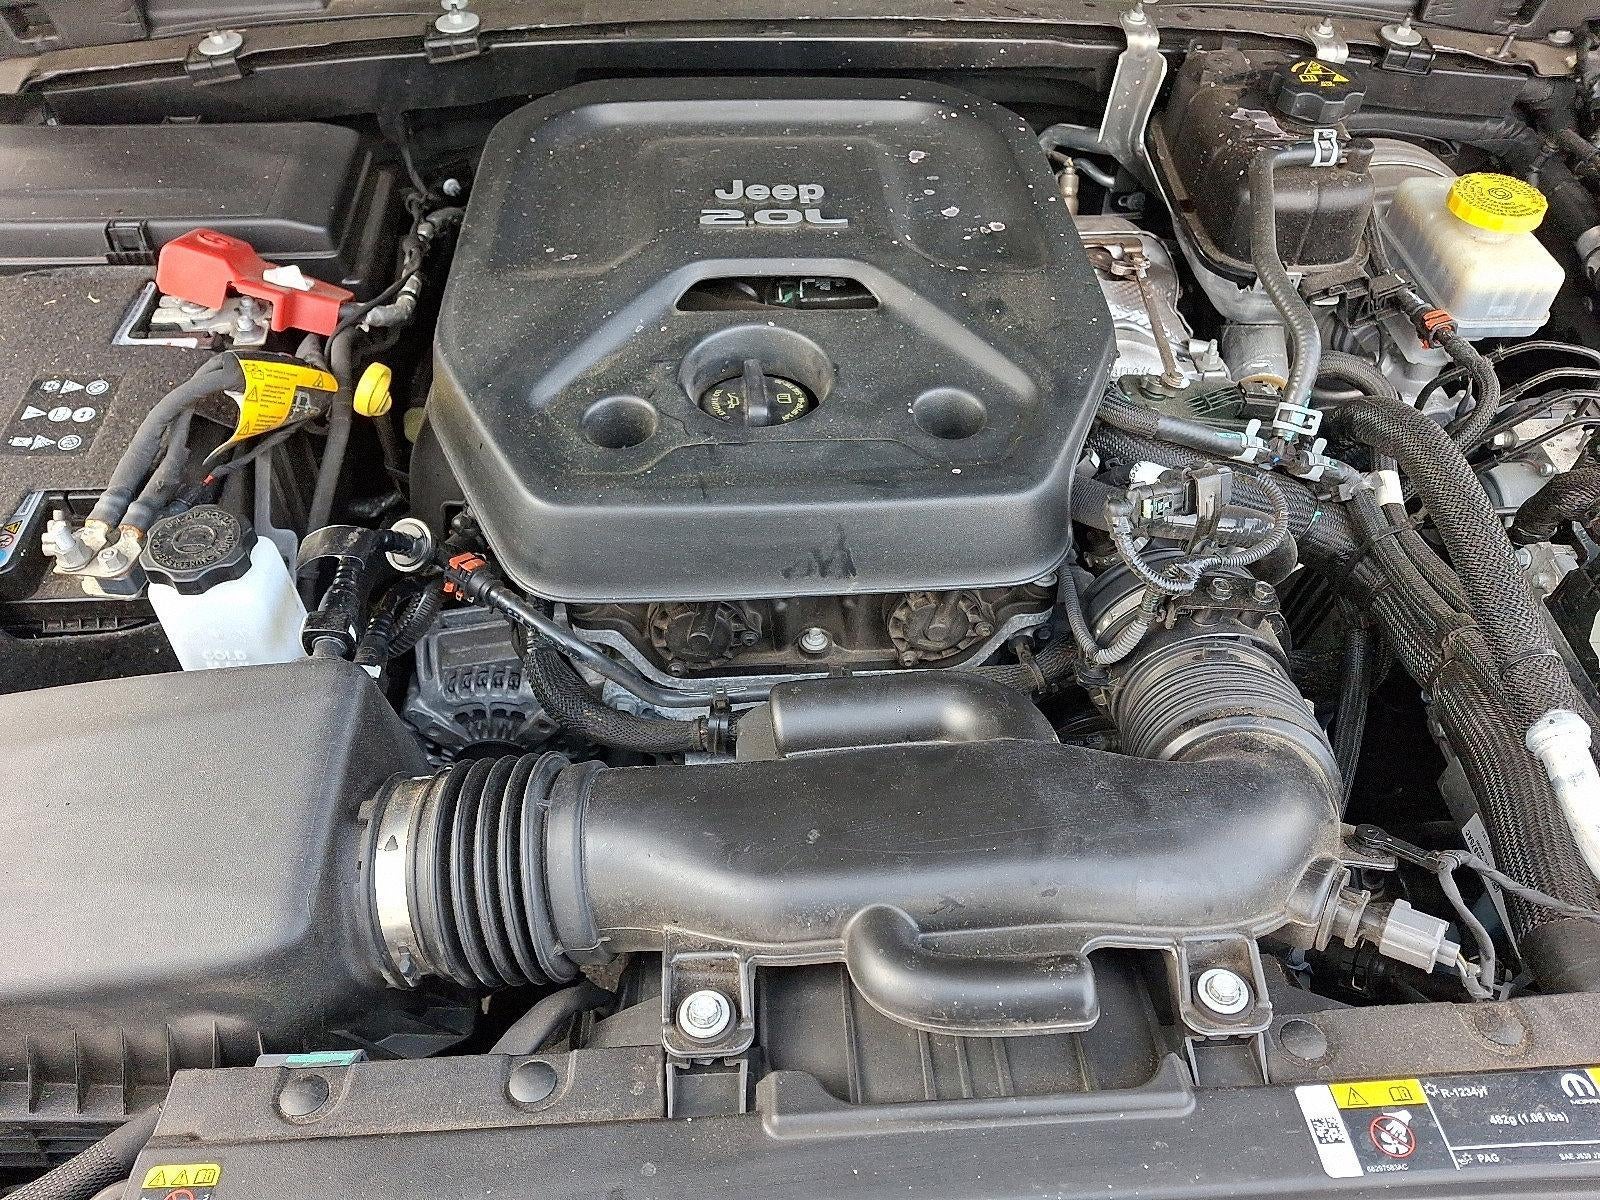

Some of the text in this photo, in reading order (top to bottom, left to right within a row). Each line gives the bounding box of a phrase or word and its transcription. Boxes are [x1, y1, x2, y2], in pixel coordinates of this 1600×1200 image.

[715, 179, 825, 204] Jeep
[700, 208, 848, 226] 2.0L
[1440, 1085, 1489, 1099] R-1234yf
[1489, 1114, 1518, 1126] 482g
[1546, 1111, 1570, 1124] lbs)
[1477, 1153, 1500, 1164] PAG
[1558, 1152, 1575, 1161] SAE
